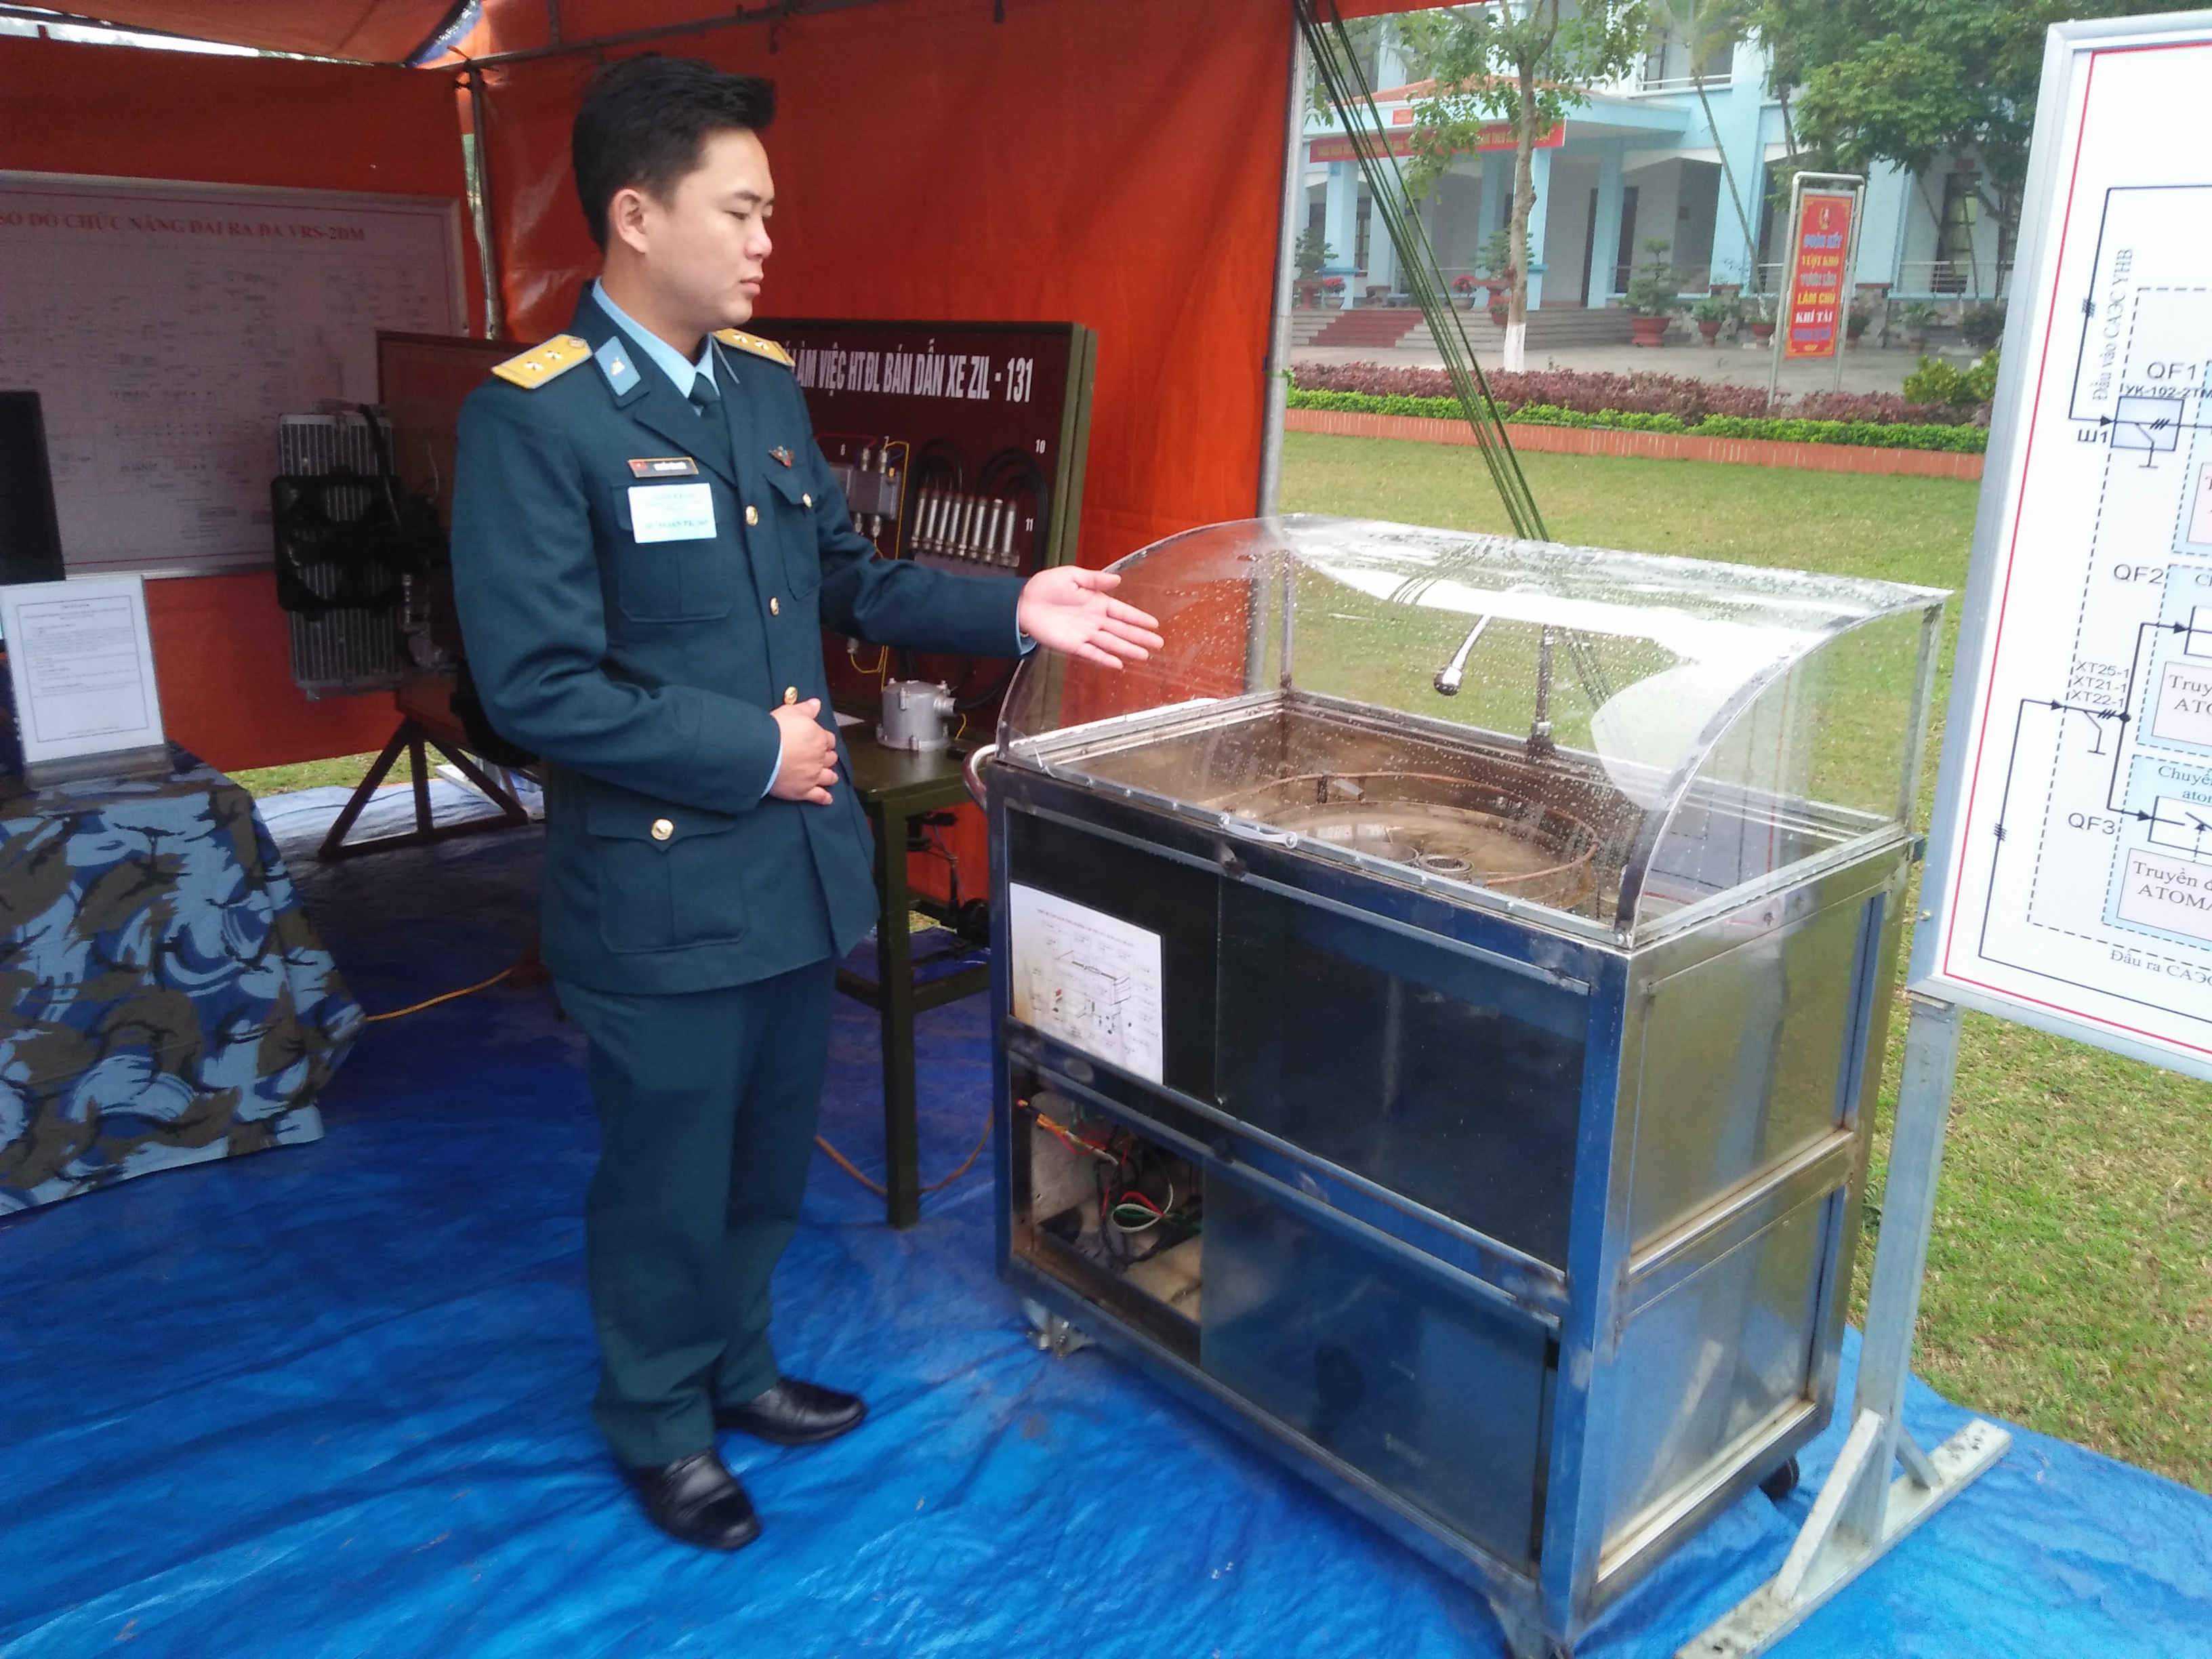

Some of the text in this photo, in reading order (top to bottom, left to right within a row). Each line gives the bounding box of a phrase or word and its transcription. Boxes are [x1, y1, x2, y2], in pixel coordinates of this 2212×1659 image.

[228, 222, 254, 236] RA
[1796, 308, 1832, 323] KHÍ TÀI
[819, 342, 846, 396] VIỆC
[882, 344, 914, 394] BÁN
[945, 354, 967, 398] XE
[967, 356, 990, 400] ZIL
[1006, 357, 1033, 403] 131
[2147, 361, 2196, 380] QF1
[1036, 438, 1046, 454] 10
[1025, 518, 1033, 532] 11
[2114, 564, 2164, 584] QF2
[2076, 660, 2129, 678] XT25-1
[2073, 674, 2127, 693] XT21-1
[2070, 689, 2124, 708] XT22-1
[2068, 813, 2115, 835] QF3
[2133, 861, 2197, 887] Truyền
[2110, 949, 2142, 967] Đầu
[2146, 961, 2161, 972] ra
